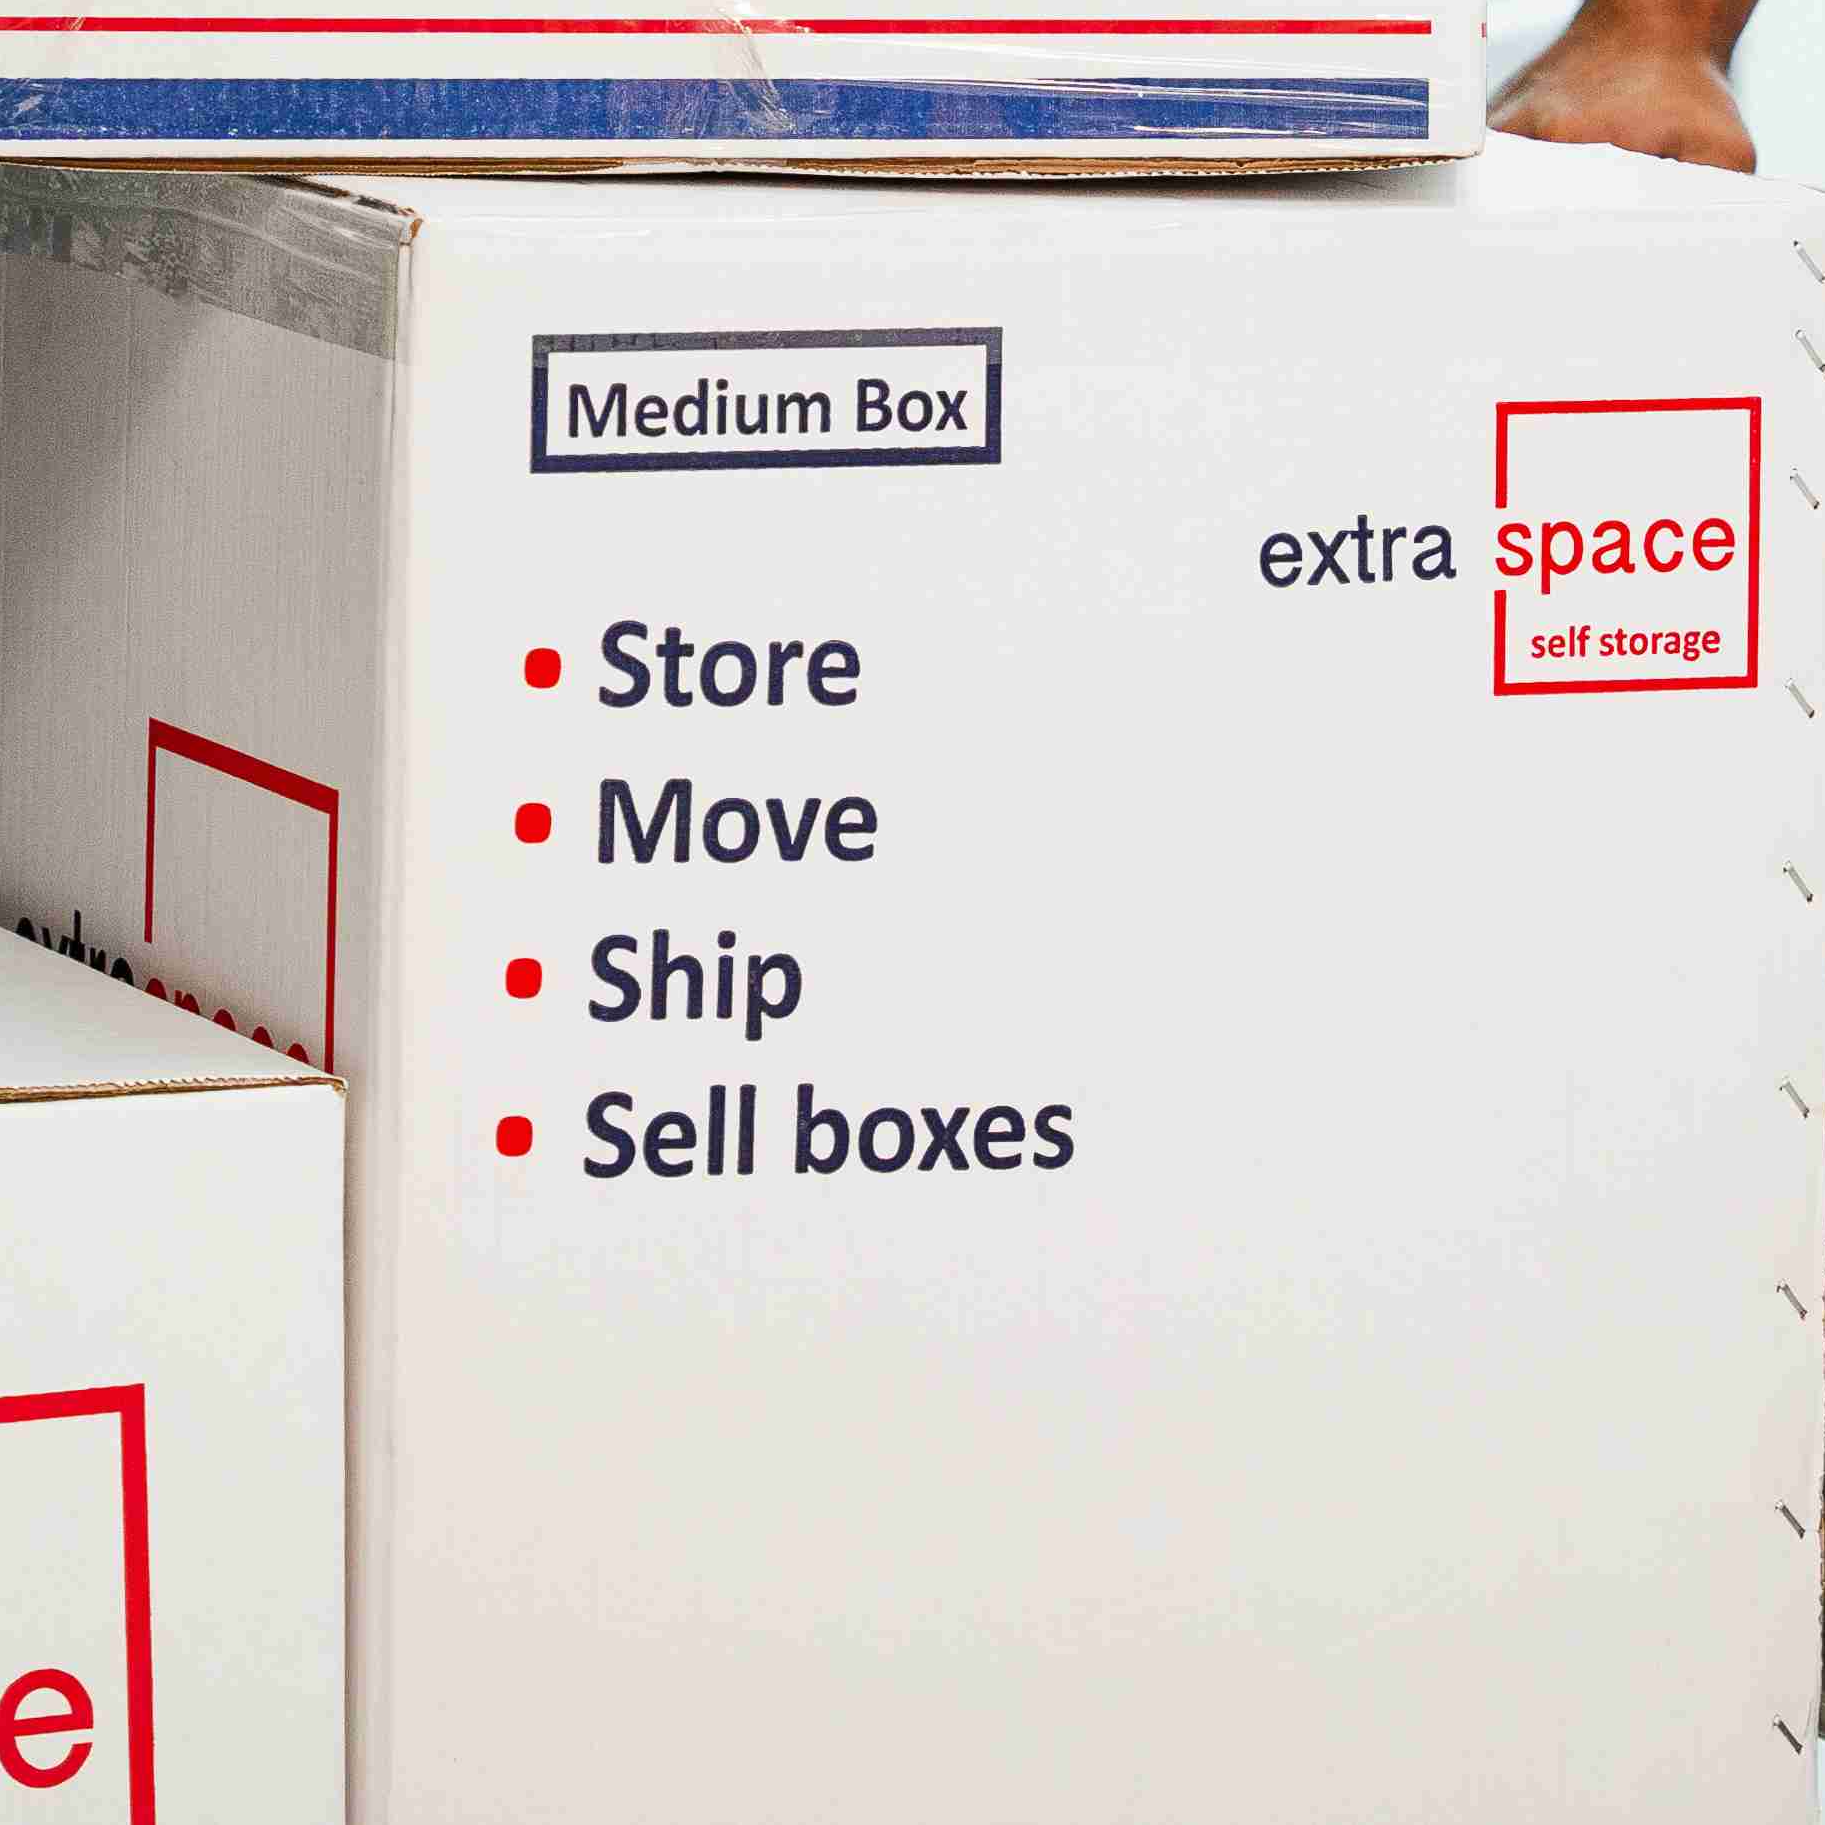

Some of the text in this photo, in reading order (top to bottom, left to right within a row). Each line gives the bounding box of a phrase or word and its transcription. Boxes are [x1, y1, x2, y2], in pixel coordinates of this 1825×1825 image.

[568, 377, 968, 438] Medium Box
[1259, 514, 1736, 595] extra space
[599, 620, 861, 708] Store
[1531, 624, 1721, 662] self storage
[598, 778, 878, 864] Move
[588, 930, 802, 1042] Ship
[583, 1083, 1074, 1179] Sell boxes
